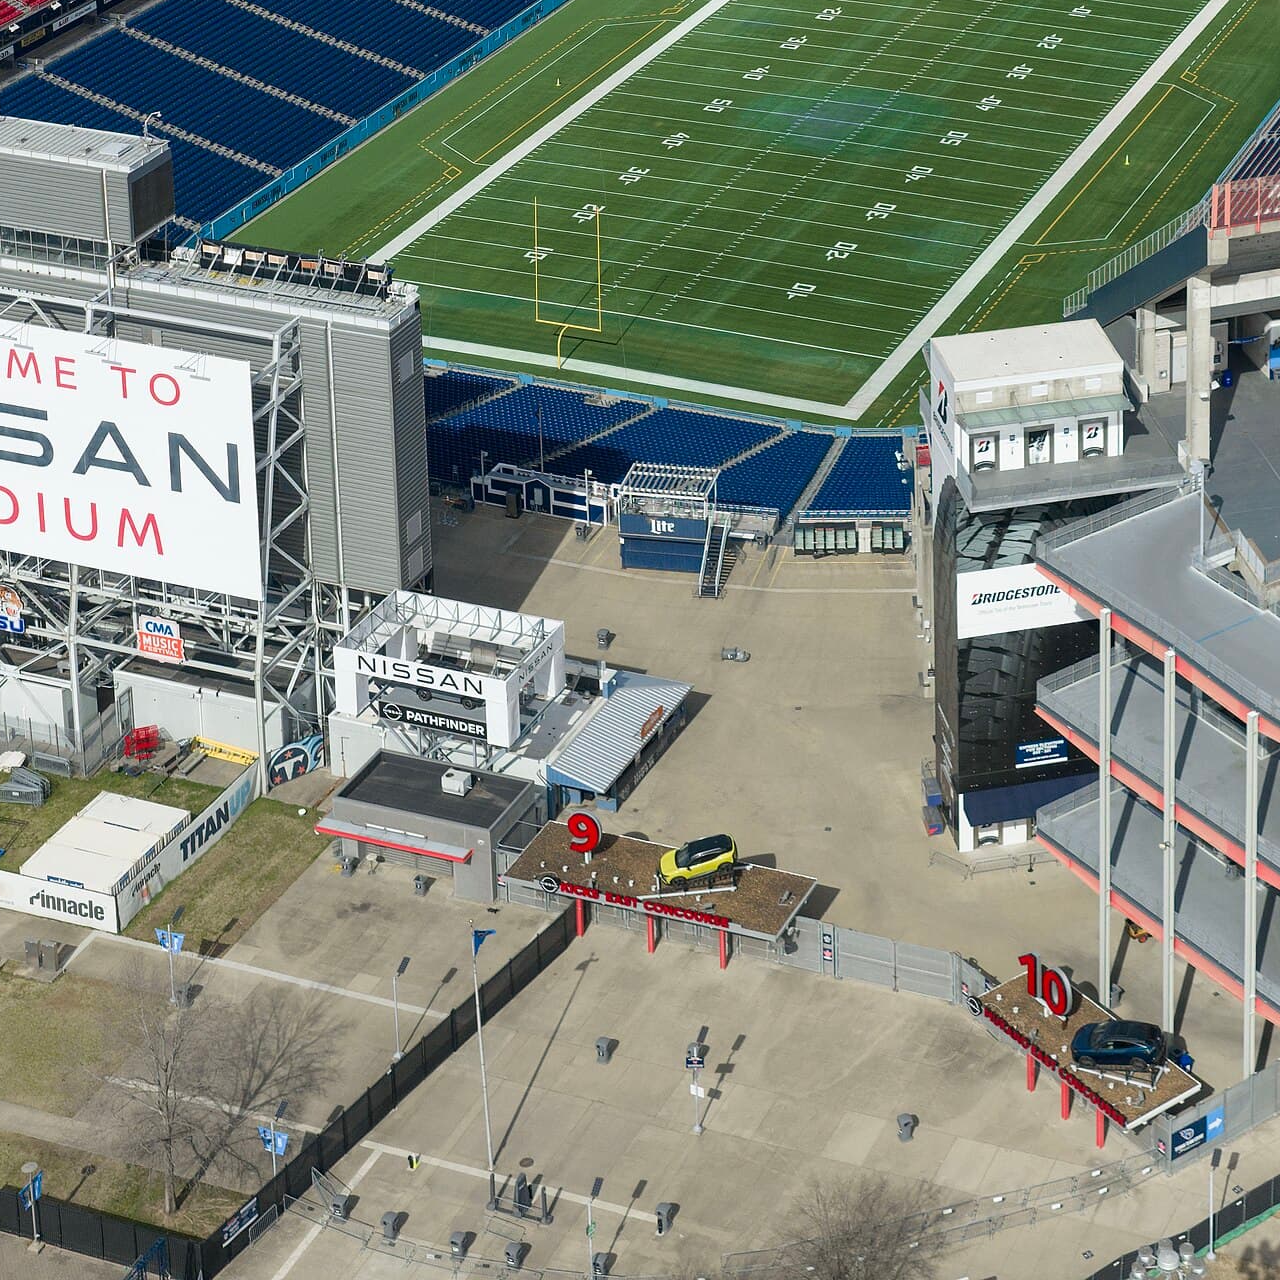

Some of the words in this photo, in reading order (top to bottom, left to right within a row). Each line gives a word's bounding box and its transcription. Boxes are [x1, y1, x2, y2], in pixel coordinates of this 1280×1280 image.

[1069, 6, 1092, 18] 10
[1037, 35, 1063, 49] 20
[1006, 66, 1033, 80] 30
[976, 97, 1002, 111] 40
[940, 130, 968, 145] 50
[908, 165, 933, 181] 40
[868, 202, 896, 219] 30
[829, 241, 857, 259] 20
[790, 282, 816, 298] 10
[110, 365, 181, 406] TO
[650, 519, 675, 534] Lite
[972, 584, 1061, 605] BRIDGESTONE
[145, 621, 174, 637] CMA
[143, 635, 179, 651] MUSIC
[143, 645, 179, 657] FESTIVAL
[519, 642, 553, 685] NISSAN
[358, 655, 483, 695] NISSAN
[406, 710, 485, 736] PATHFINDER
[567, 811, 600, 853] 9
[29, 889, 105, 920] Pinnacle
[560, 882, 599, 900] KICKS
[606, 891, 638, 909] EAST
[643, 901, 730, 928] CONCOURSE
[1018, 953, 1068, 1016] 10
[1058, 1068, 1128, 1127] CONCOURSE
